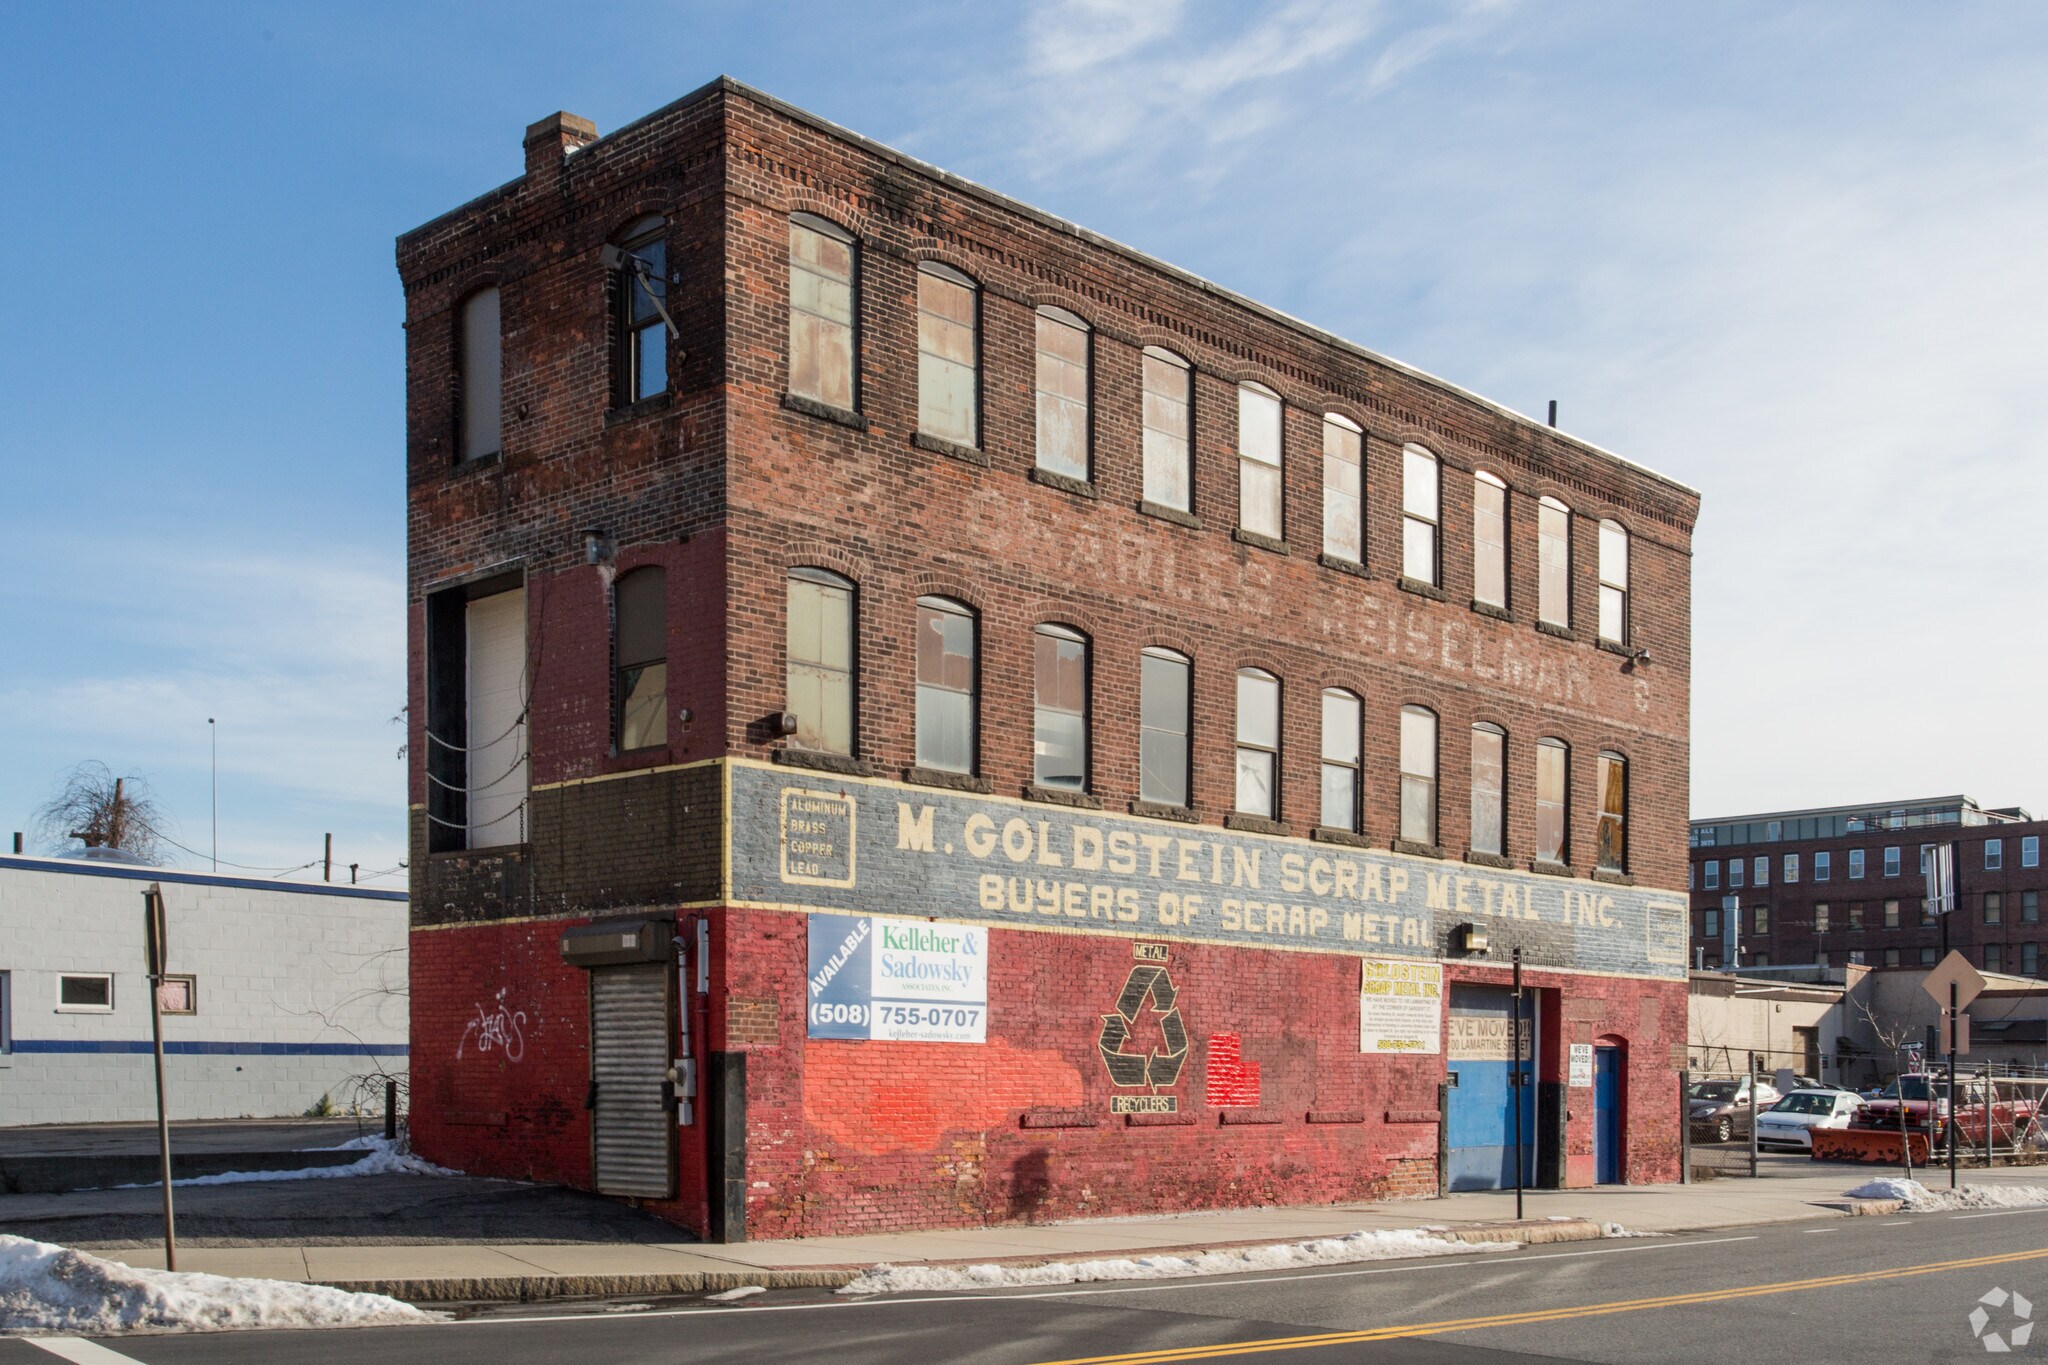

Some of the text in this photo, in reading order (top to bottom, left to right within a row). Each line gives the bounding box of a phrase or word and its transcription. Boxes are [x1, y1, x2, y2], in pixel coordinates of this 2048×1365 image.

[791, 798, 846, 816] ALUMINUM
[791, 819, 827, 834] BRASS
[791, 840, 833, 857] COPPER
[790, 861, 818, 875] LEAD
[895, 801, 1623, 929] M. GOLDSTEIN SCRAP METAL INC.
[979, 874, 1433, 948] BUYERS OF SCRAP METAL
[881, 925, 978, 956] Kelleher &
[809, 919, 871, 998] AVAILABLE
[1135, 944, 1167, 960] METAL
[881, 953, 973, 988] Sadowsky
[1365, 962, 1440, 982] GOLDSTEIN
[1363, 980, 1440, 998] SCRAP METAL INC.
[811, 1003, 979, 1027] (508) 755-0707
[888, 1029, 971, 1041] kelleher-sadowsky.com
[1449, 1019, 1473, 1037] E'VE
[1461, 1040, 1501, 1051] LAMARTINE
[1503, 1040, 1529, 1051] STRET
[1117, 1098, 1169, 1112] RECYCLERS
